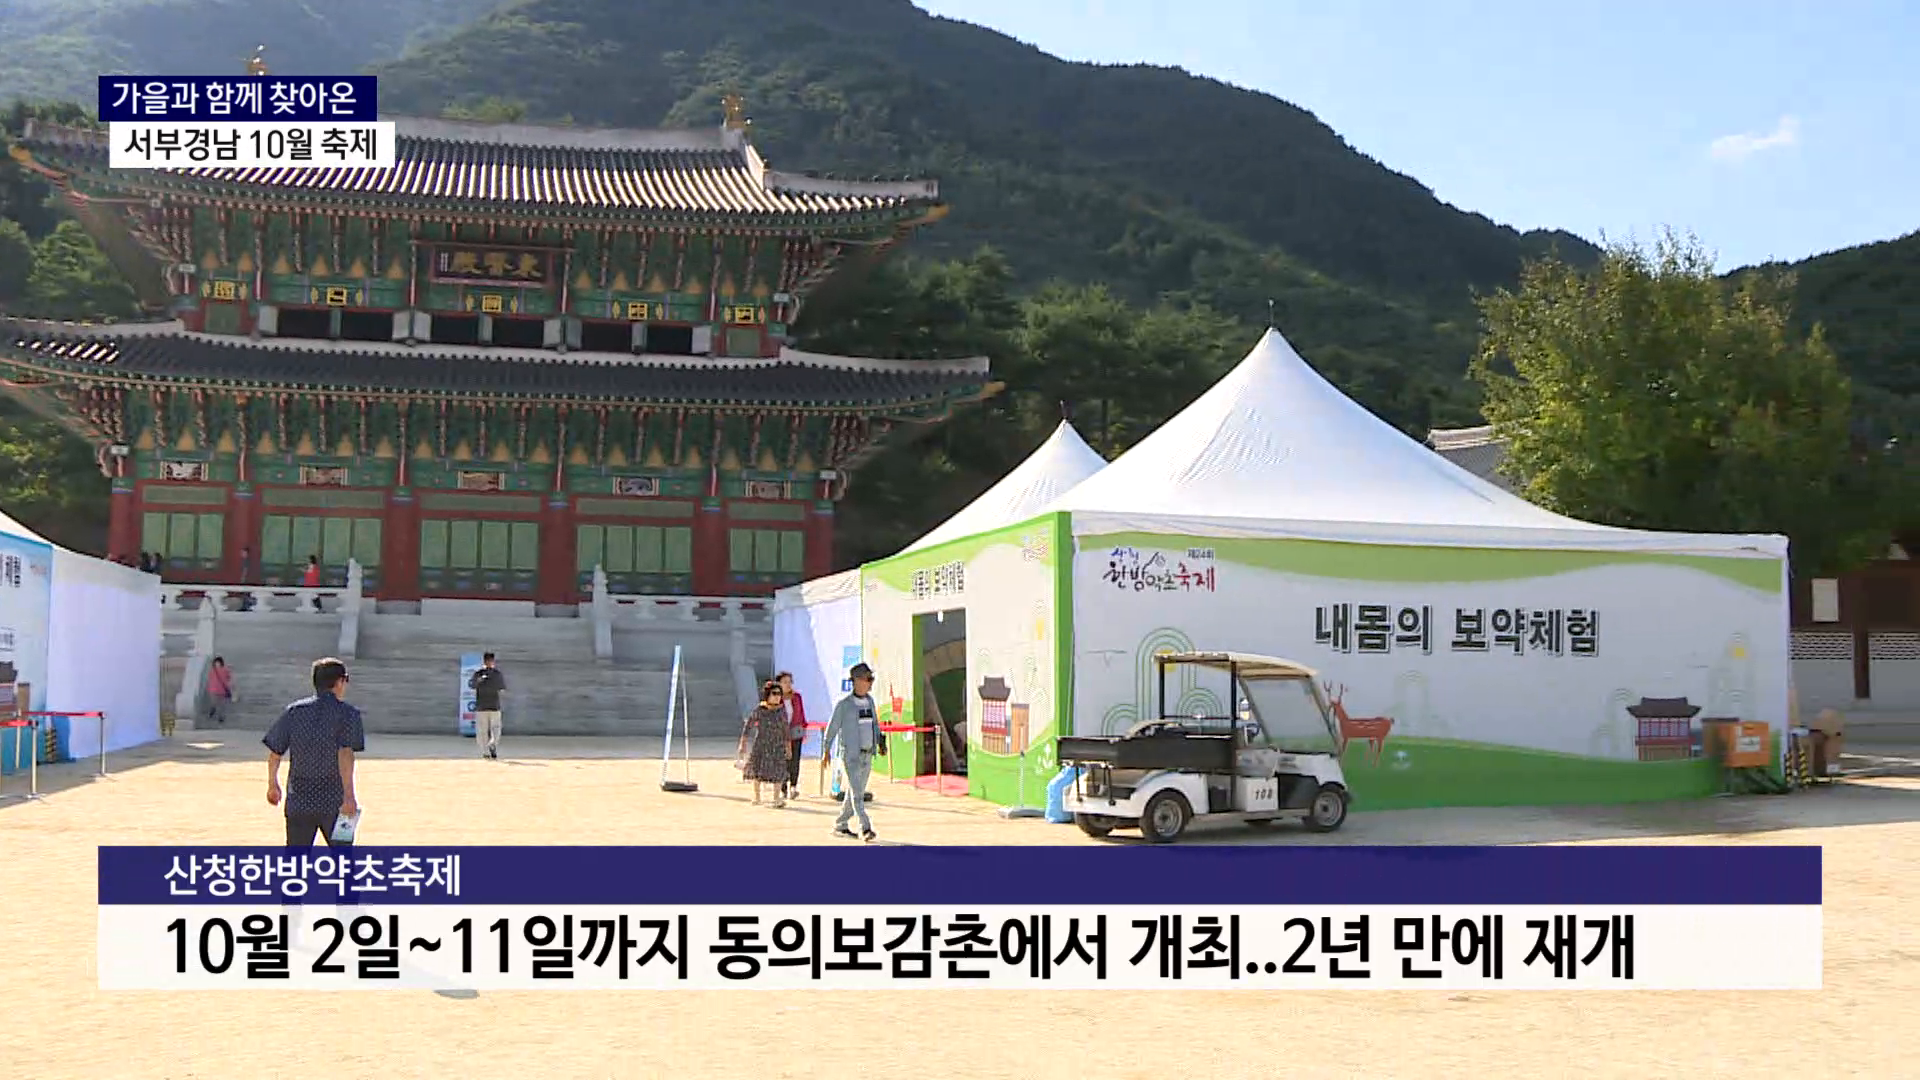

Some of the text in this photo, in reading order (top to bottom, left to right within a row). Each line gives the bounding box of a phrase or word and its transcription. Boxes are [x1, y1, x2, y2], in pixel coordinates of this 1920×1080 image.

[1102, 560, 1215, 592] 한방약초축제
[1315, 603, 1599, 656] 내몸의 보약체험
